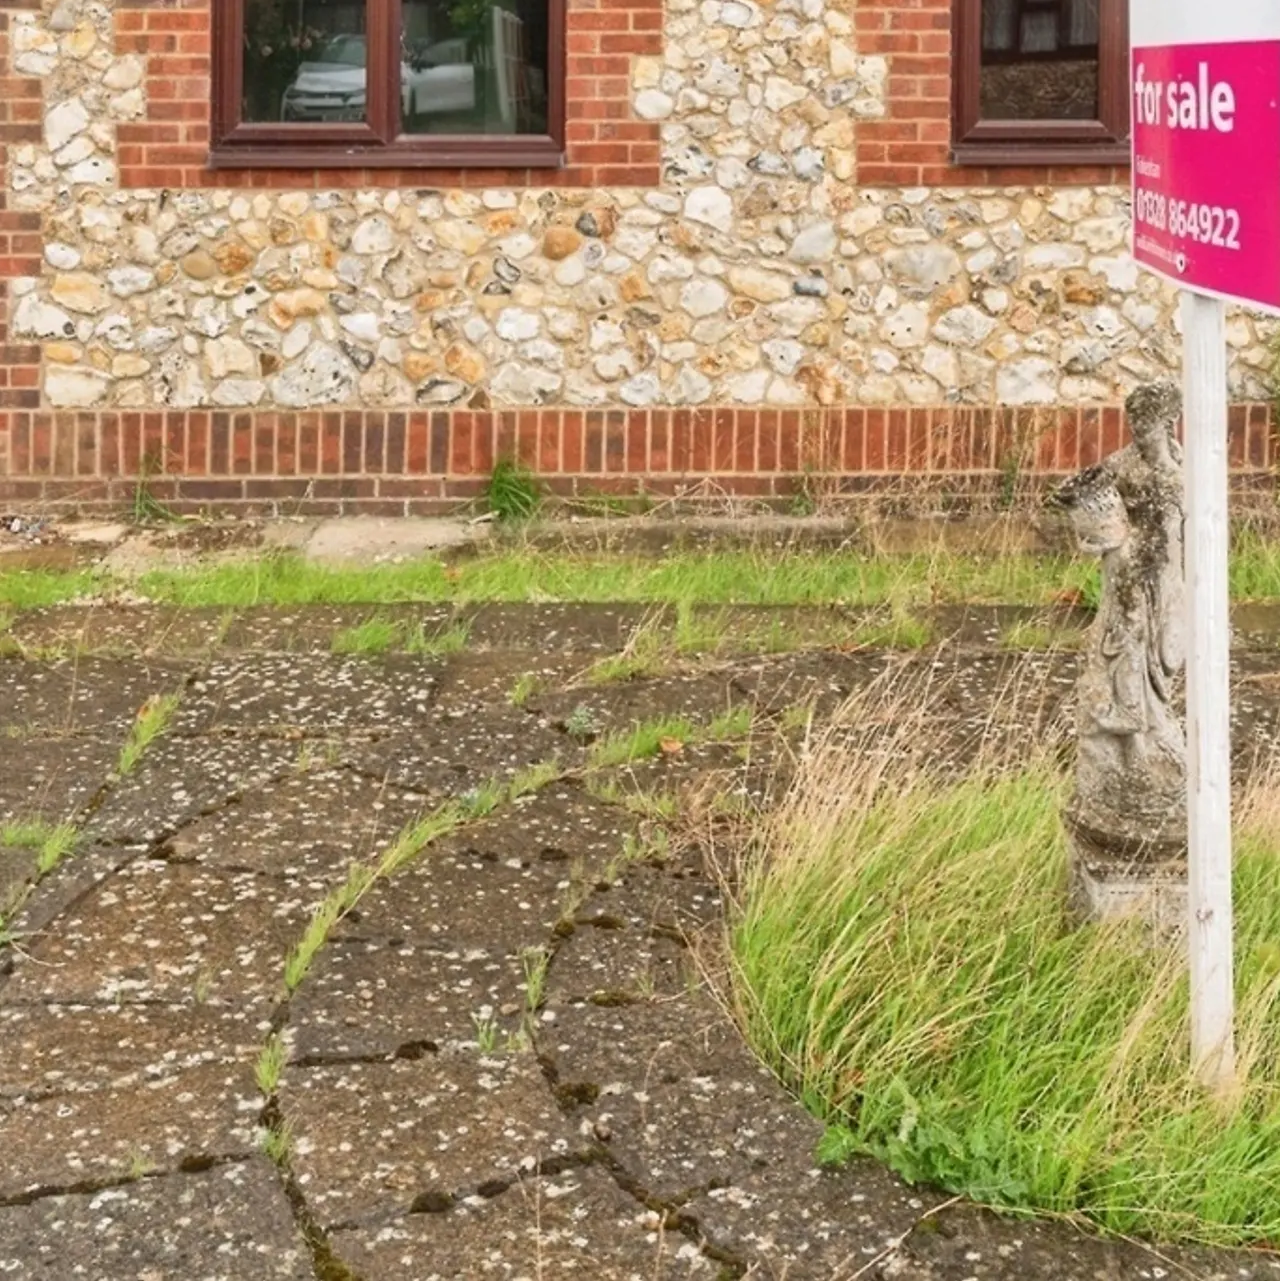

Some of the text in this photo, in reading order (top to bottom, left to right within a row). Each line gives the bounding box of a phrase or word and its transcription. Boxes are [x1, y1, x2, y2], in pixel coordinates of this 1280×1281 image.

[1135, 62, 1235, 132] for sale
[1168, 197, 1241, 250] 864922
